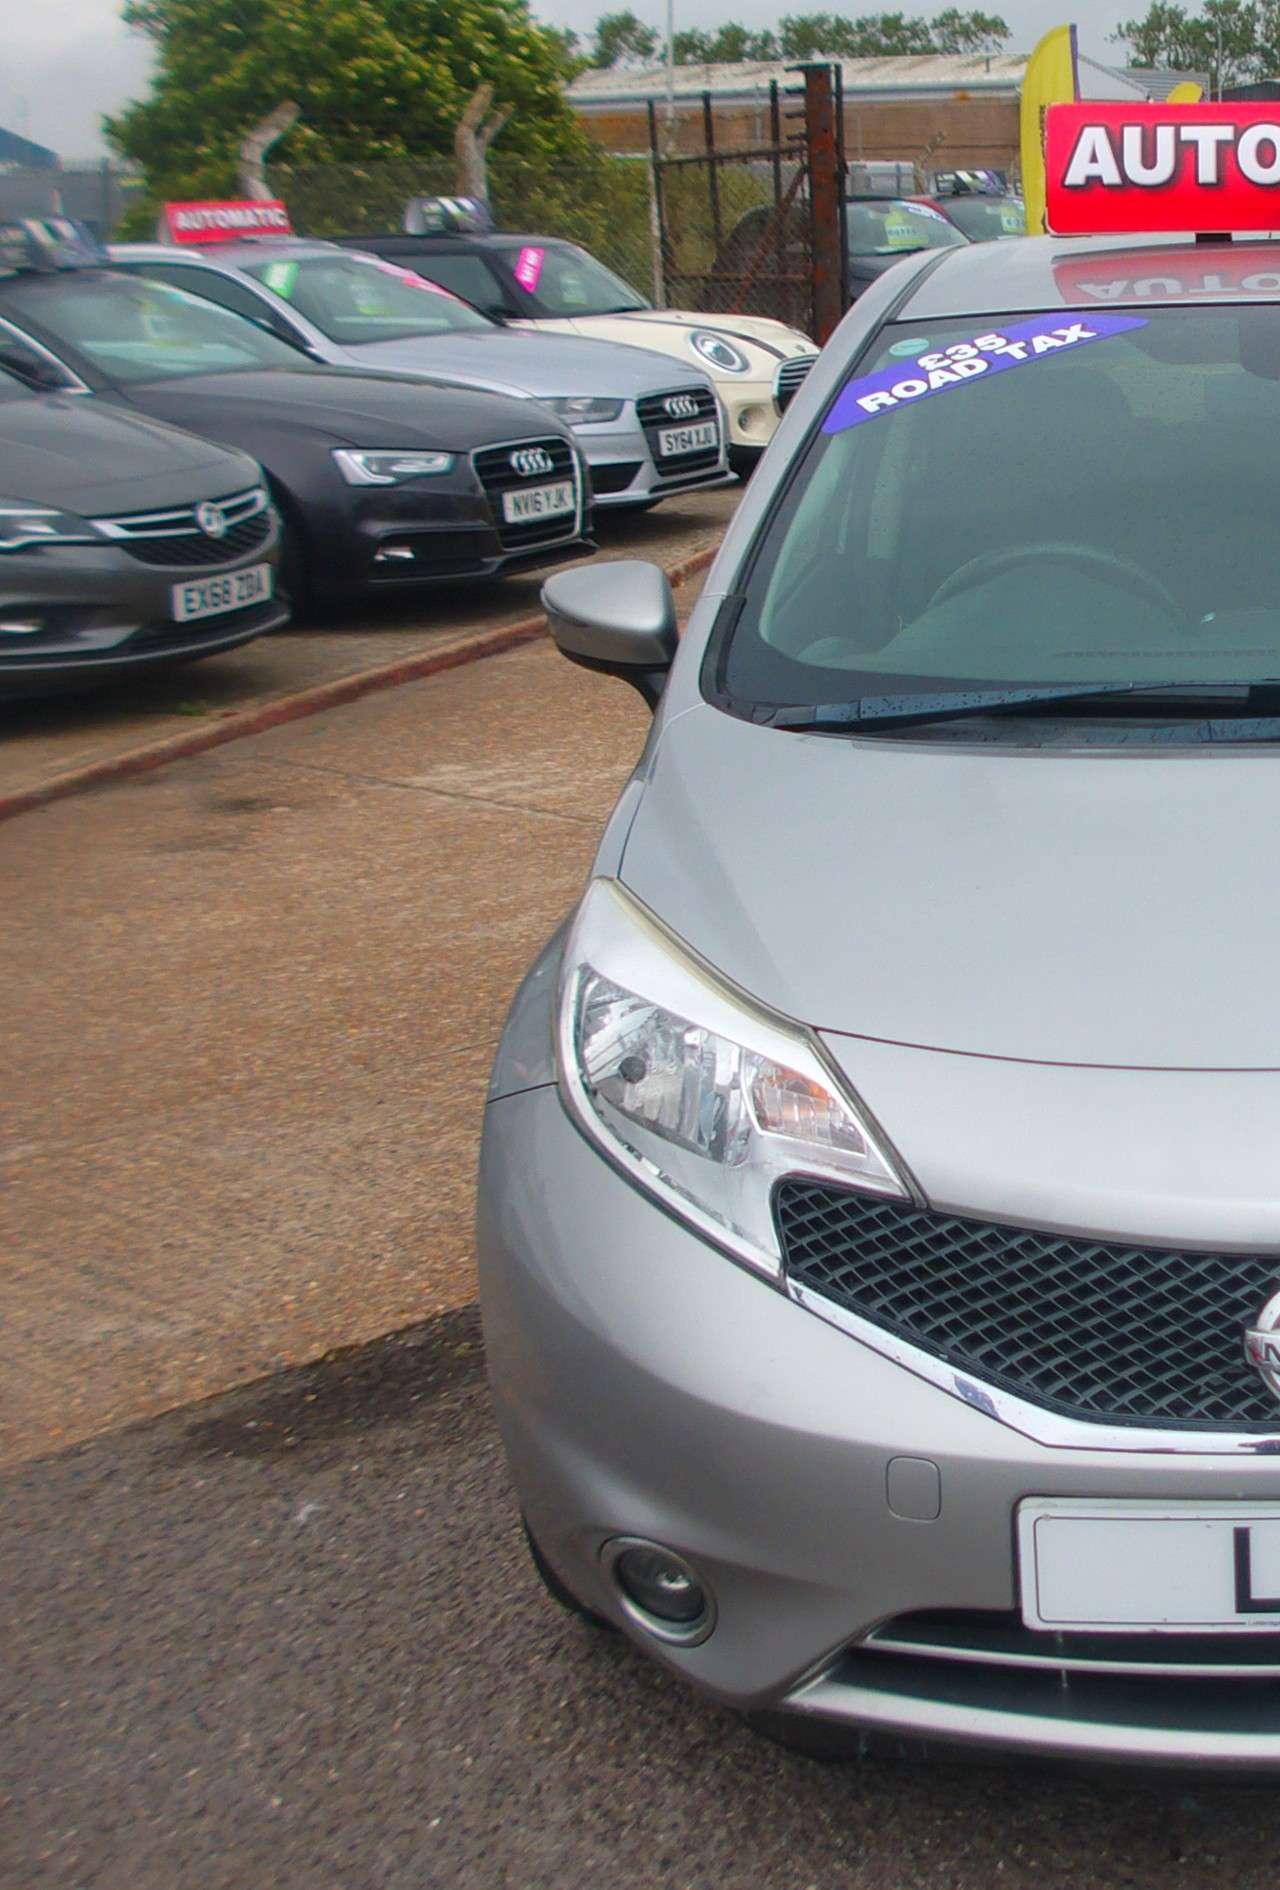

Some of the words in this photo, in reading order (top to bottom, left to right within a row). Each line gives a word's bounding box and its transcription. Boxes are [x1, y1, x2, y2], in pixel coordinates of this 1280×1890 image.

[176, 207, 290, 231] AUTOMATIC
[856, 358, 988, 413] ROAD
[994, 323, 1097, 360] TAX
[917, 334, 1007, 371] £35
